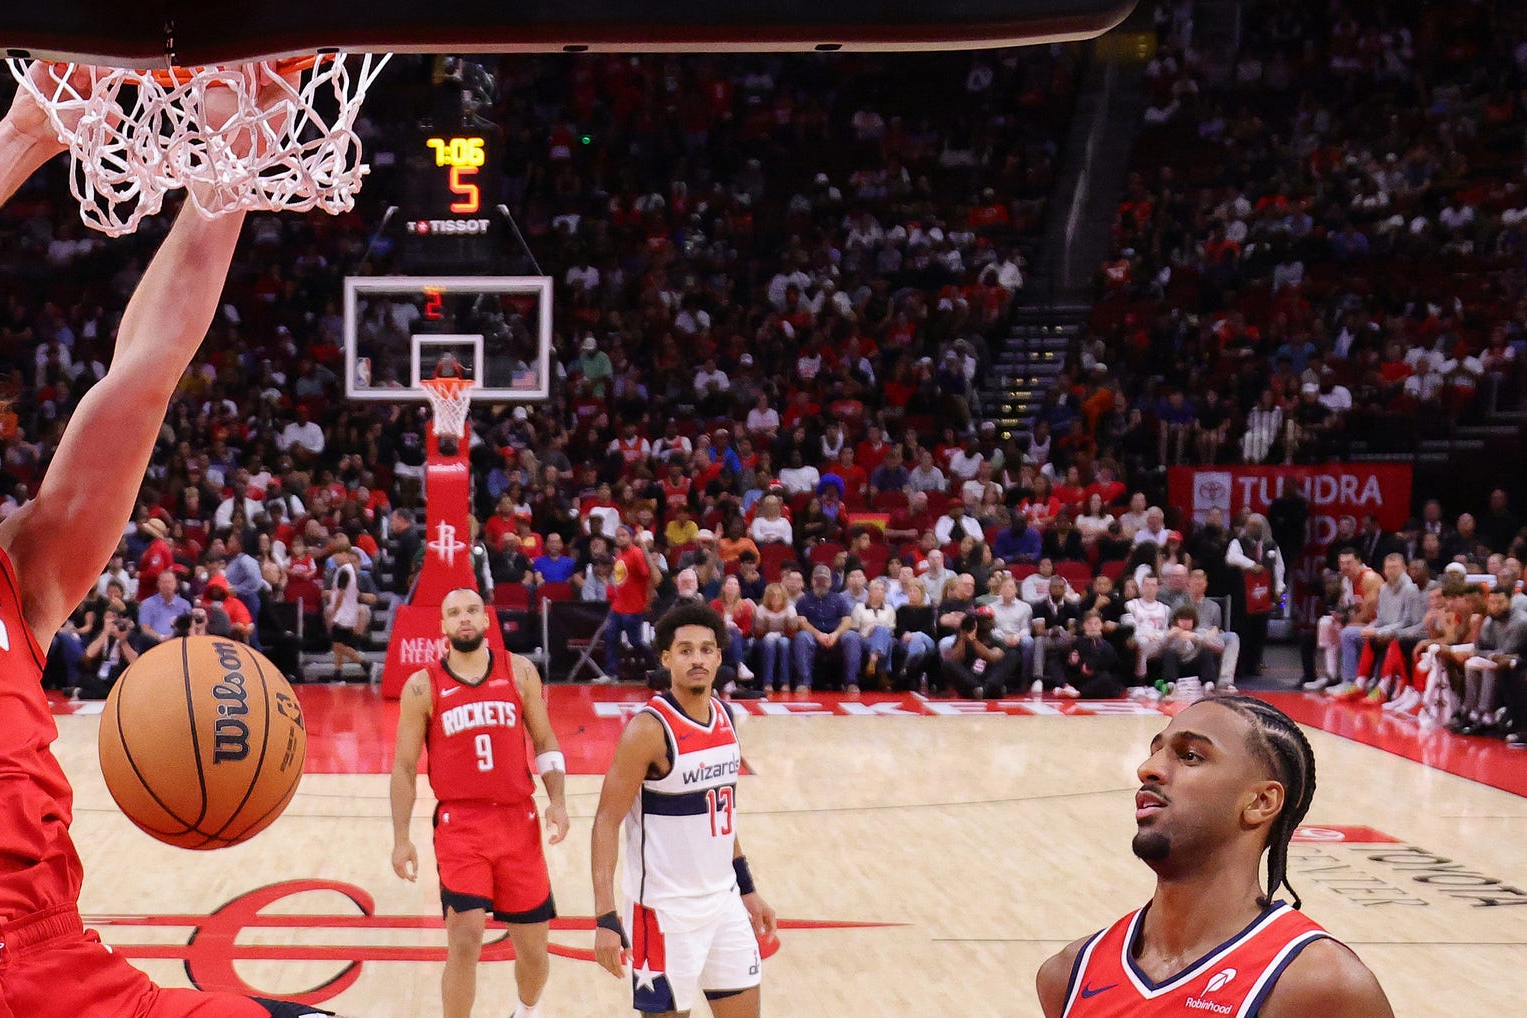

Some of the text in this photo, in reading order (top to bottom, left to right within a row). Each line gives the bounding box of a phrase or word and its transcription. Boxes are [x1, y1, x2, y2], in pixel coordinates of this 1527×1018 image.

[426, 138, 485, 166] 7:06
[449, 166, 480, 213] 5
[430, 219, 490, 234] TISSOT
[212, 642, 250, 765] Wilson
[441, 701, 516, 737] ROCKETS
[475, 734, 494, 772] 9
[682, 752, 740, 785] wizards
[706, 786, 734, 838] 13
[1185, 996, 1233, 1015] Robinhood
